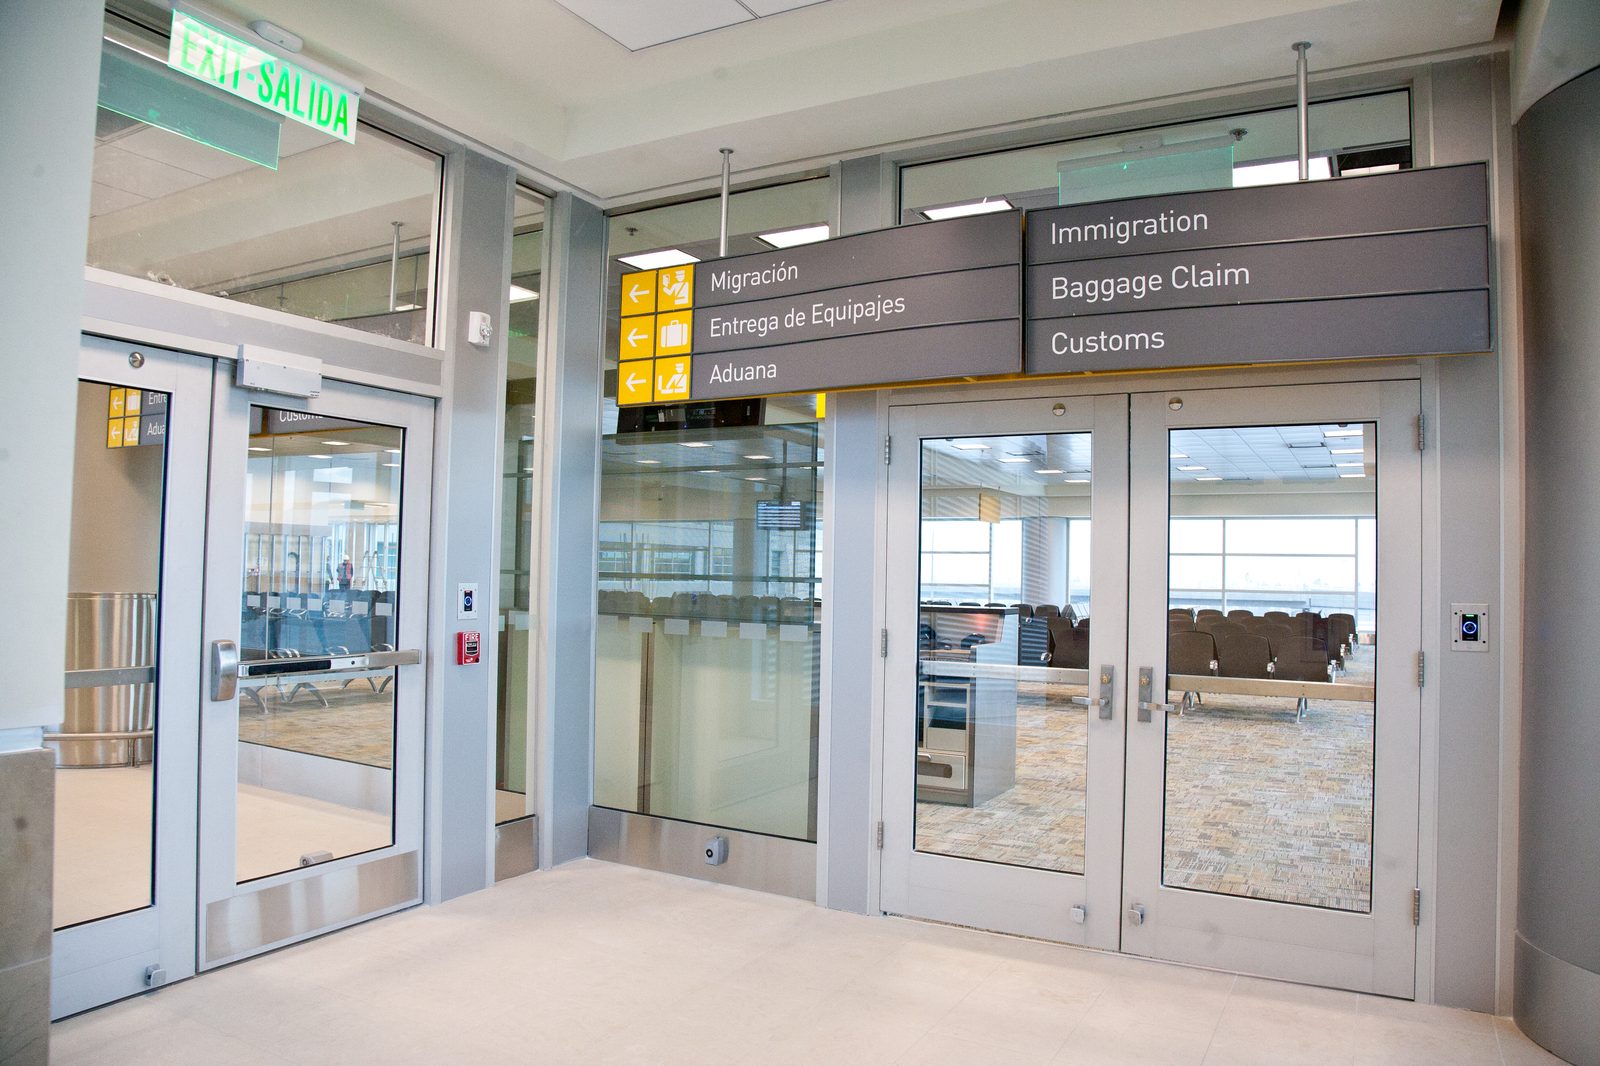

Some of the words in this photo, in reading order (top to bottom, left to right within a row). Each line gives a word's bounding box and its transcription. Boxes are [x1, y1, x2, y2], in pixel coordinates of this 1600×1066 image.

[180, 22, 349, 137] EXIT-SALIDA
[1051, 210, 1208, 245] Immigration
[711, 261, 798, 294] Migración
[1052, 273, 1163, 303] Baggage
[1171, 262, 1250, 290] Claim
[710, 315, 779, 338] Entrega
[784, 308, 806, 328] de
[812, 294, 906, 327] Equipajes
[1051, 330, 1165, 355] Customs
[709, 363, 777, 385] Aduana
